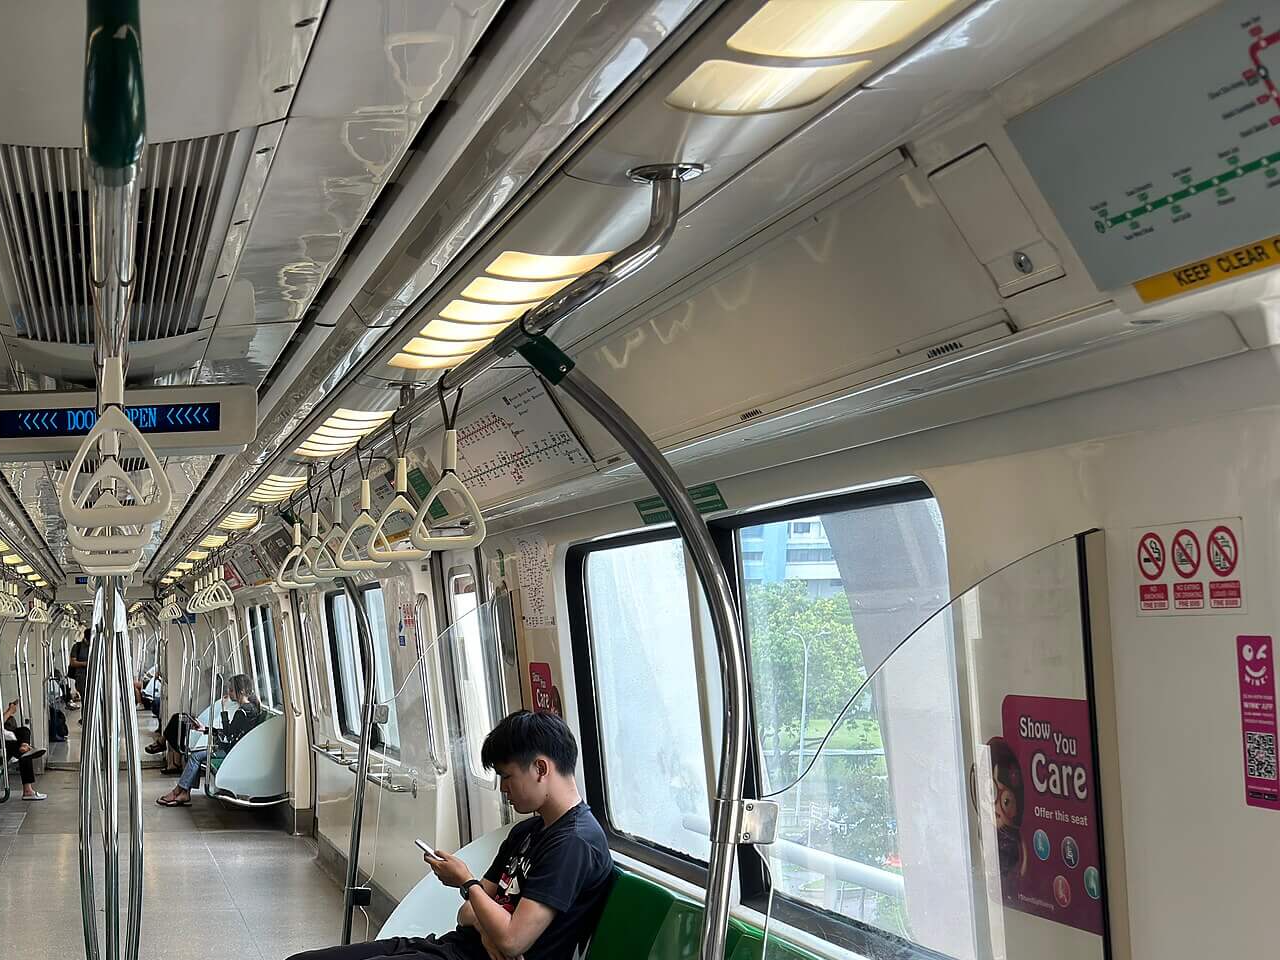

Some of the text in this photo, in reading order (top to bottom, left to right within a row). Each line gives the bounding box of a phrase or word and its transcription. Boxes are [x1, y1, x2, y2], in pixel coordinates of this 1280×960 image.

[1172, 263, 1211, 287] KEEP
[1216, 245, 1270, 272] CLEAR
[67, 410, 97, 430] DOO
[1019, 717, 1050, 740] Show
[1053, 732, 1077, 756] You
[1031, 752, 1088, 800] Care
[1034, 805, 1088, 827] Offer this seat
